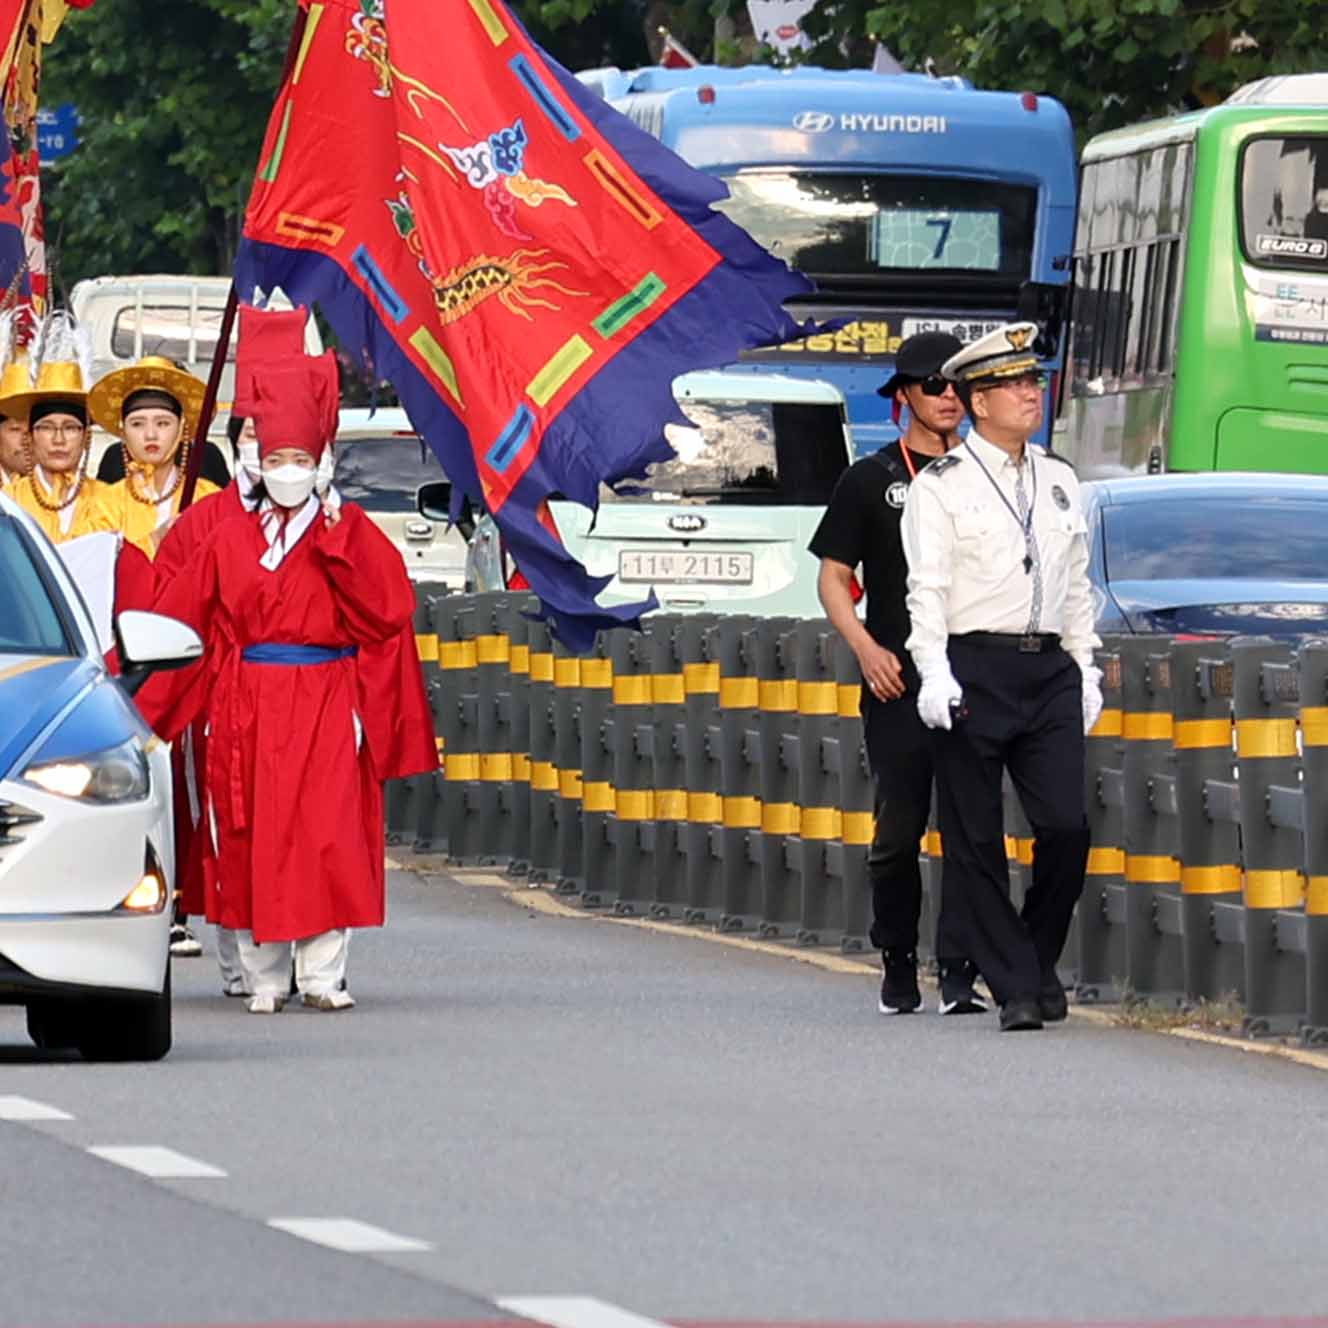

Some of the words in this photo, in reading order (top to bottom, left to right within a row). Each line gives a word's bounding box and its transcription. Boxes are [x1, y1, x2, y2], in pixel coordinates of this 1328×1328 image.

[840, 114, 947, 134] HYUNDAI
[926, 219, 952, 260] 7
[1260, 239, 1309, 253] EURO
[684, 556, 742, 577] 2115
